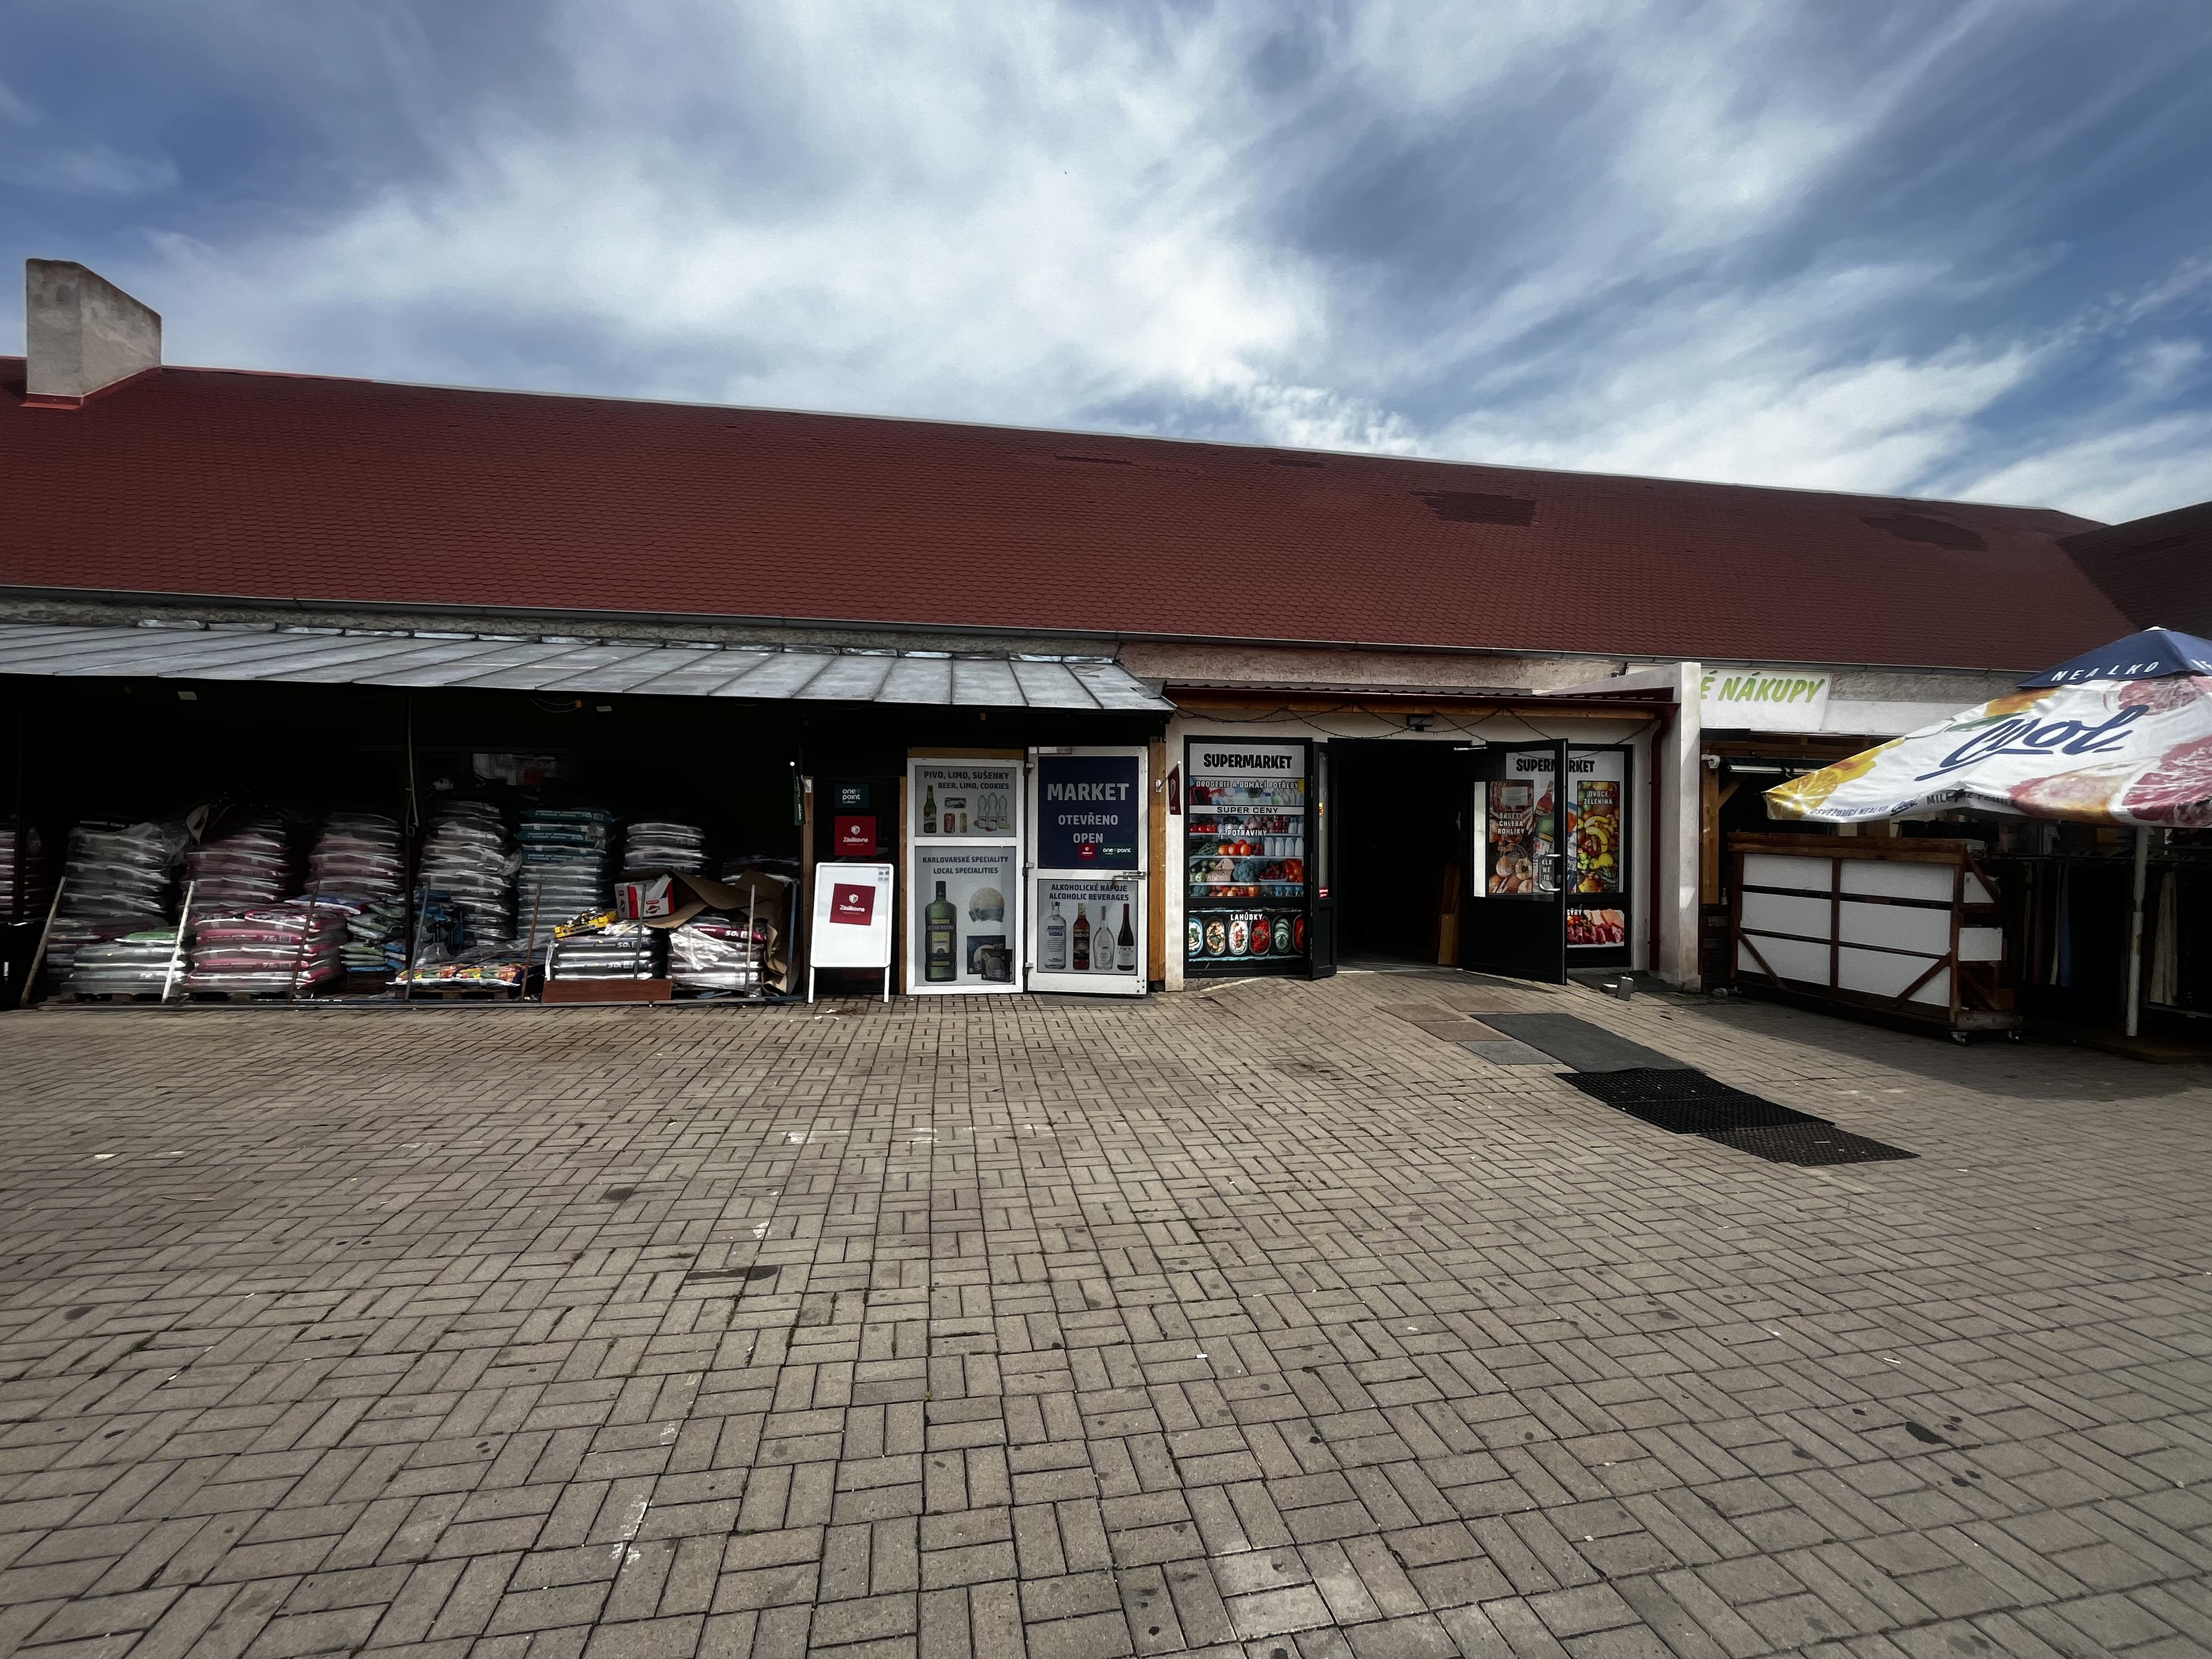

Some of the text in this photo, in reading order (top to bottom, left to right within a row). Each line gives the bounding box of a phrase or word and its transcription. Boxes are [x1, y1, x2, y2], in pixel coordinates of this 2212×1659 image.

[2051, 661, 2159, 681] NEALKO
[1718, 671, 1825, 703] NÁKUPY
[1203, 753, 1293, 769] SUPERMARKET
[1516, 759, 1595, 773] SUPERRKET
[924, 770, 1009, 780] PIVO, LIMO, SUŠENKY
[1239, 780, 1267, 789] DOMÁCÍ
[1269, 780, 1299, 790] POTŘEBY
[1047, 783, 1130, 801] MARKET
[1058, 812, 1119, 825] OTEVŘENO
[1073, 833, 1103, 843] OPEN
[1051, 883, 1128, 892] ALKOHOLICKÉ NÁPOJE
[1230, 911, 1263, 921] LAHŮDKY
